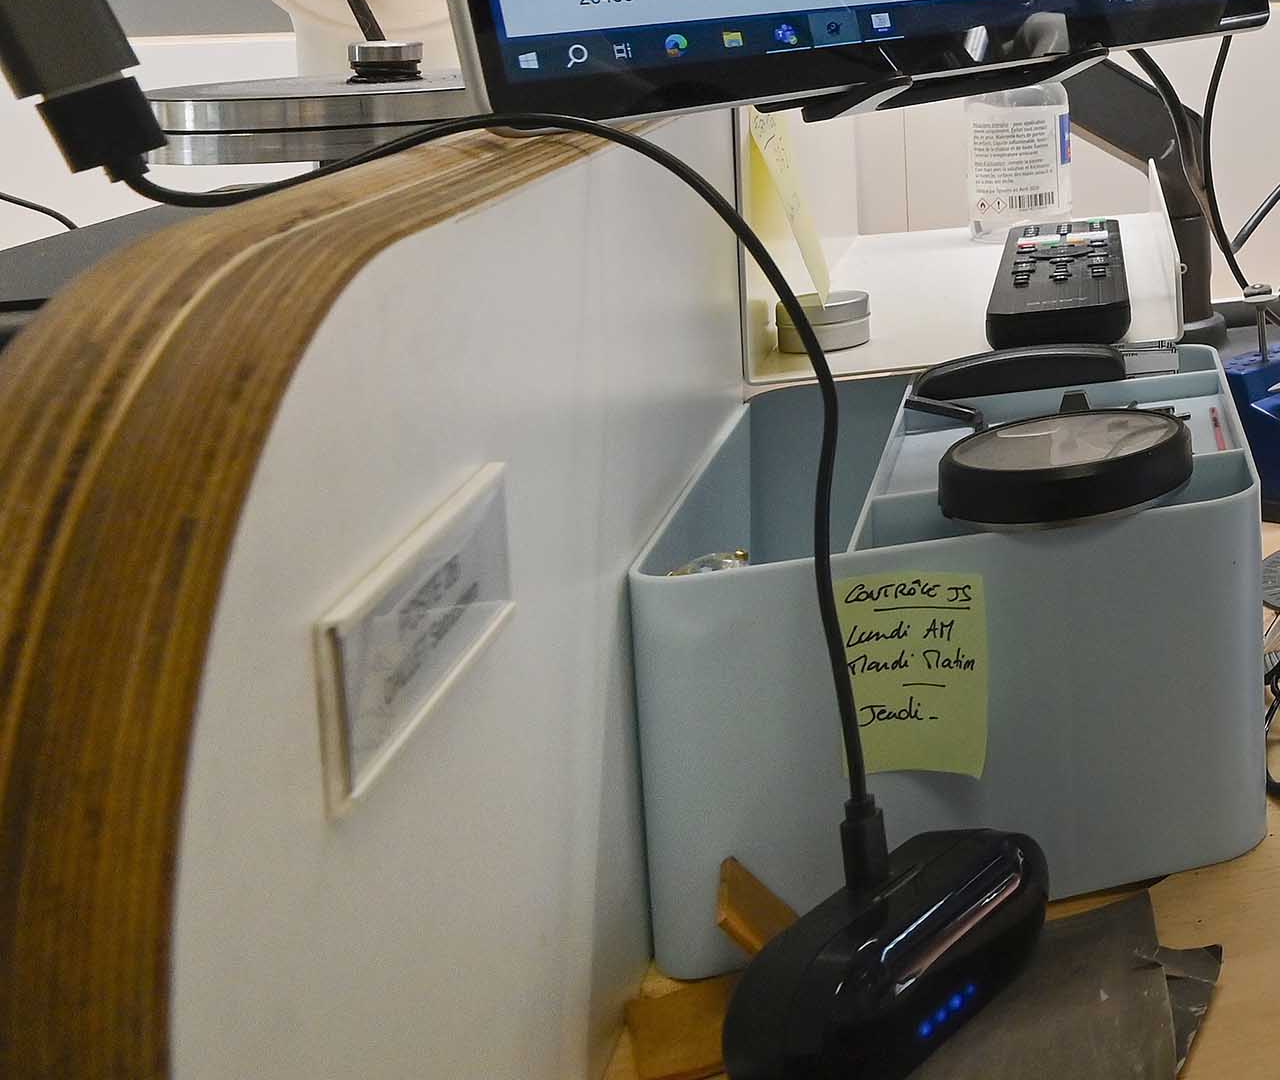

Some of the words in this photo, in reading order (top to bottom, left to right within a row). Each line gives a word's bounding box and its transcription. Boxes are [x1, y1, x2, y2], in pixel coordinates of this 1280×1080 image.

[947, 585, 972, 602] JS
[847, 621, 911, 647] Lundi
[923, 619, 954, 641] AM
[923, 647, 975, 670] Matin
